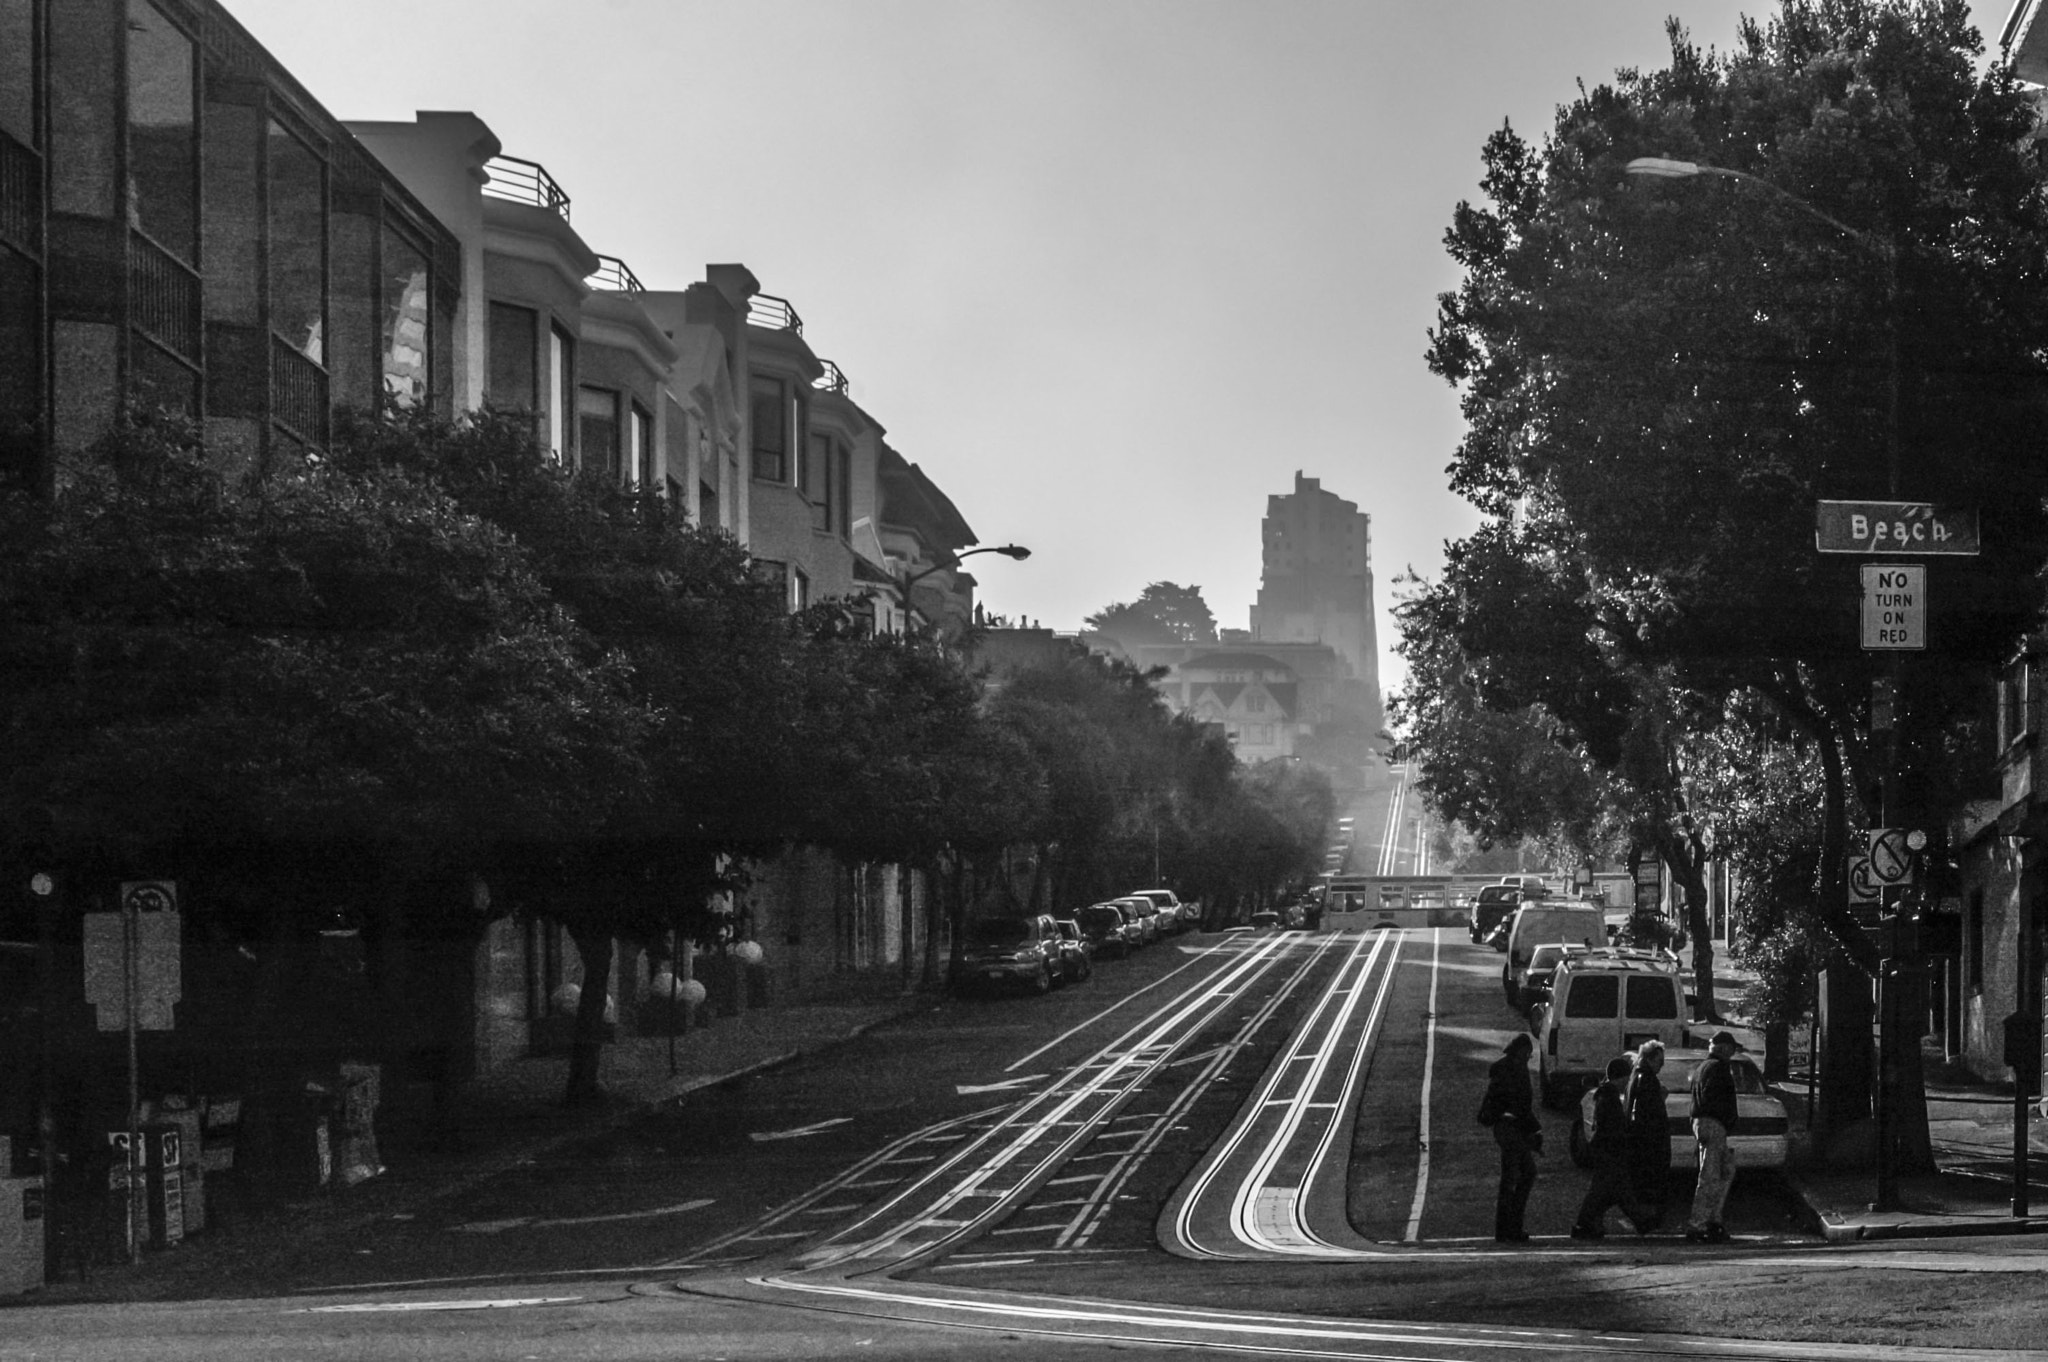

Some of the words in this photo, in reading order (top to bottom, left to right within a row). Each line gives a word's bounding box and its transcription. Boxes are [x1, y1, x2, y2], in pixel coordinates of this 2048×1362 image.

[1851, 514, 1950, 543] Beach
[1879, 572, 1908, 589] NO
[1875, 594, 1912, 607] TURN
[1883, 611, 1904, 625] ON
[1880, 629, 1908, 642] RED
